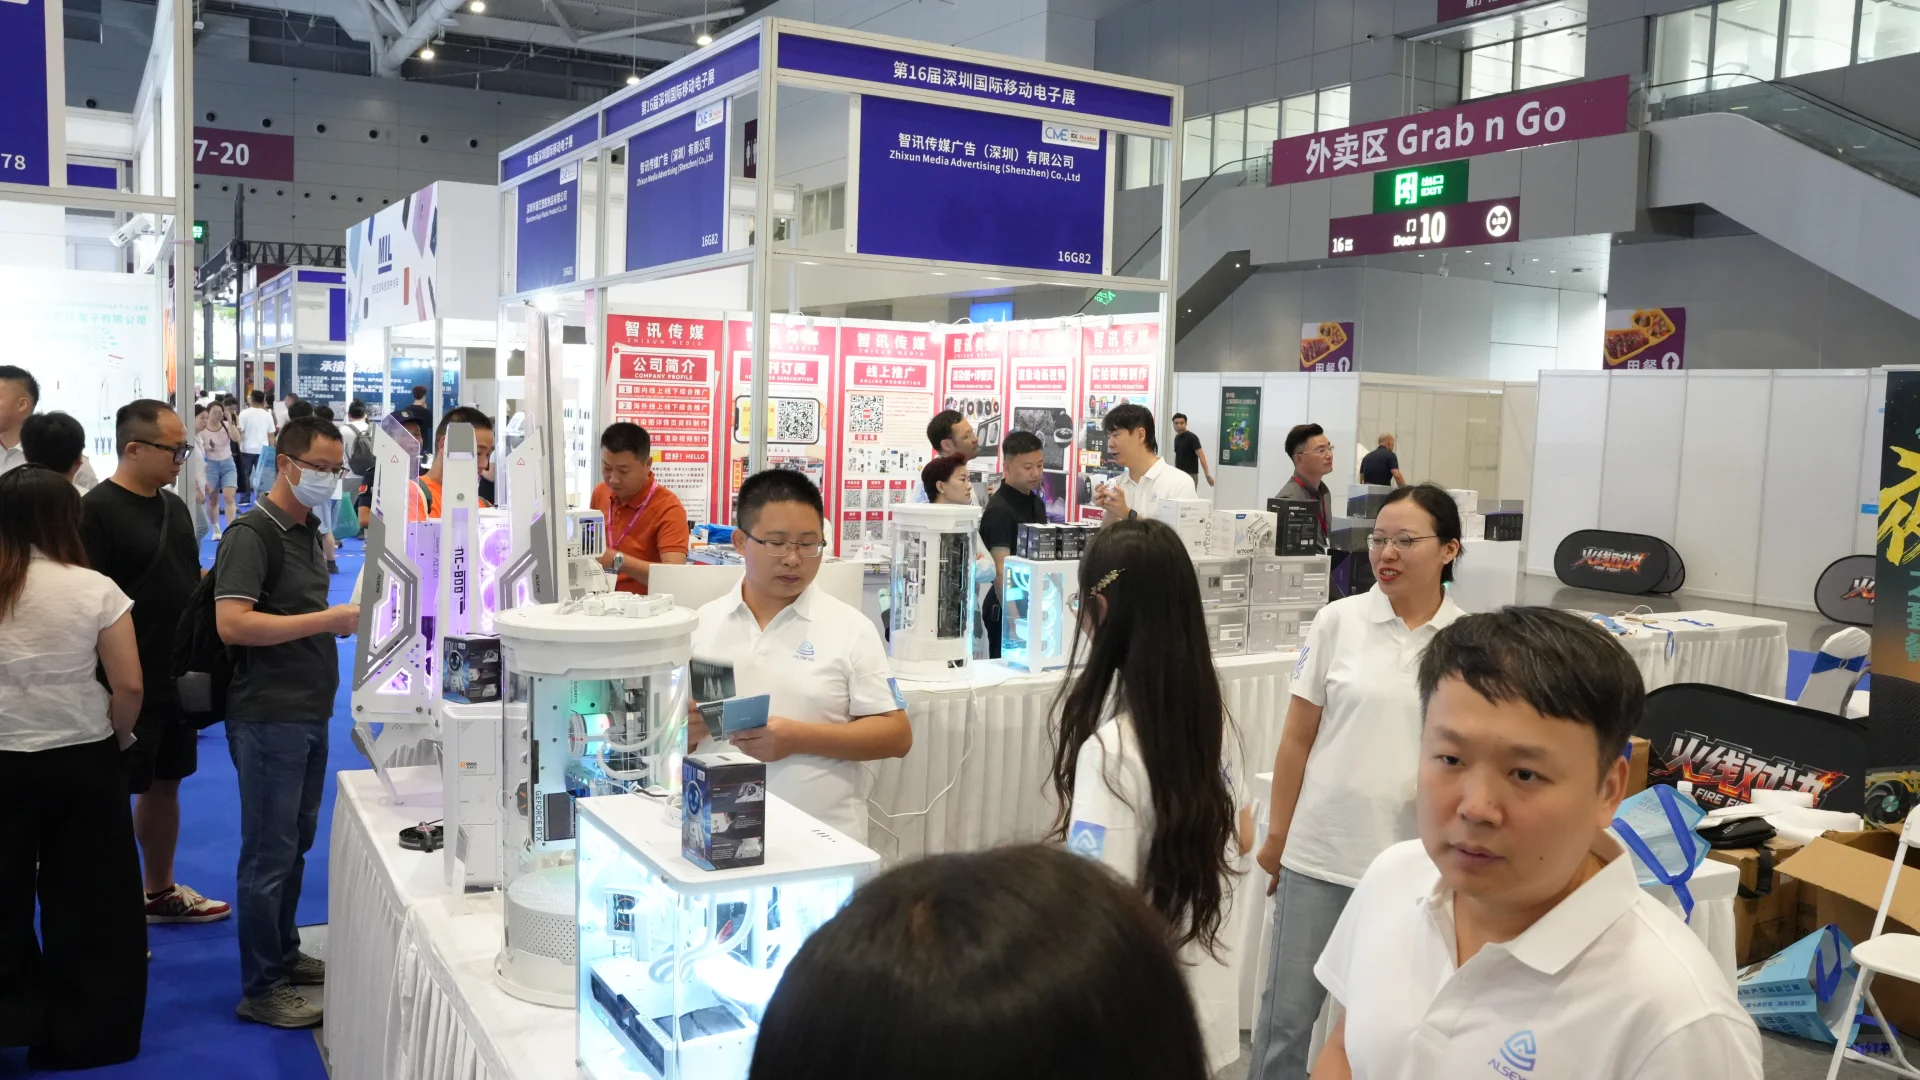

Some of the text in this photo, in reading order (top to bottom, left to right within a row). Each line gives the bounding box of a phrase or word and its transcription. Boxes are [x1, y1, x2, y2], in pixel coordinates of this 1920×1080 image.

[893, 60, 1076, 106] 第16届深圳国际移动电子展
[641, 68, 715, 117] 第16届深圳国际移动电子展
[1305, 100, 1567, 175] 外卖区 Grab n Go
[898, 132, 1074, 169] 智讯传媒广告（深圳）有限公司
[889, 150, 1081, 182] Zhixun Media Advertising (Shenzhen) Co.,Ltd
[1420, 174, 1444, 187] 出口
[1420, 186, 1444, 196] EXIT
[1393, 212, 1446, 248] Door 10
[1406, 218, 1417, 233] 门
[378, 234, 392, 264] MIL
[701, 233, 718, 248] 16G82
[1057, 250, 1092, 266] 16G82
[624, 320, 704, 340] 智讯传媒
[856, 332, 926, 350] 智讯传媒
[632, 356, 696, 374] 公司简介
[769, 362, 806, 376] 刊订阅
[866, 365, 916, 379] 线上推广
[633, 387, 708, 396] 国内线上线下综合推广
[633, 402, 708, 411] 海外线上线下综合推广
[1575, 547, 1647, 573] 火线对决
[1694, 788, 1724, 806] FIRE
